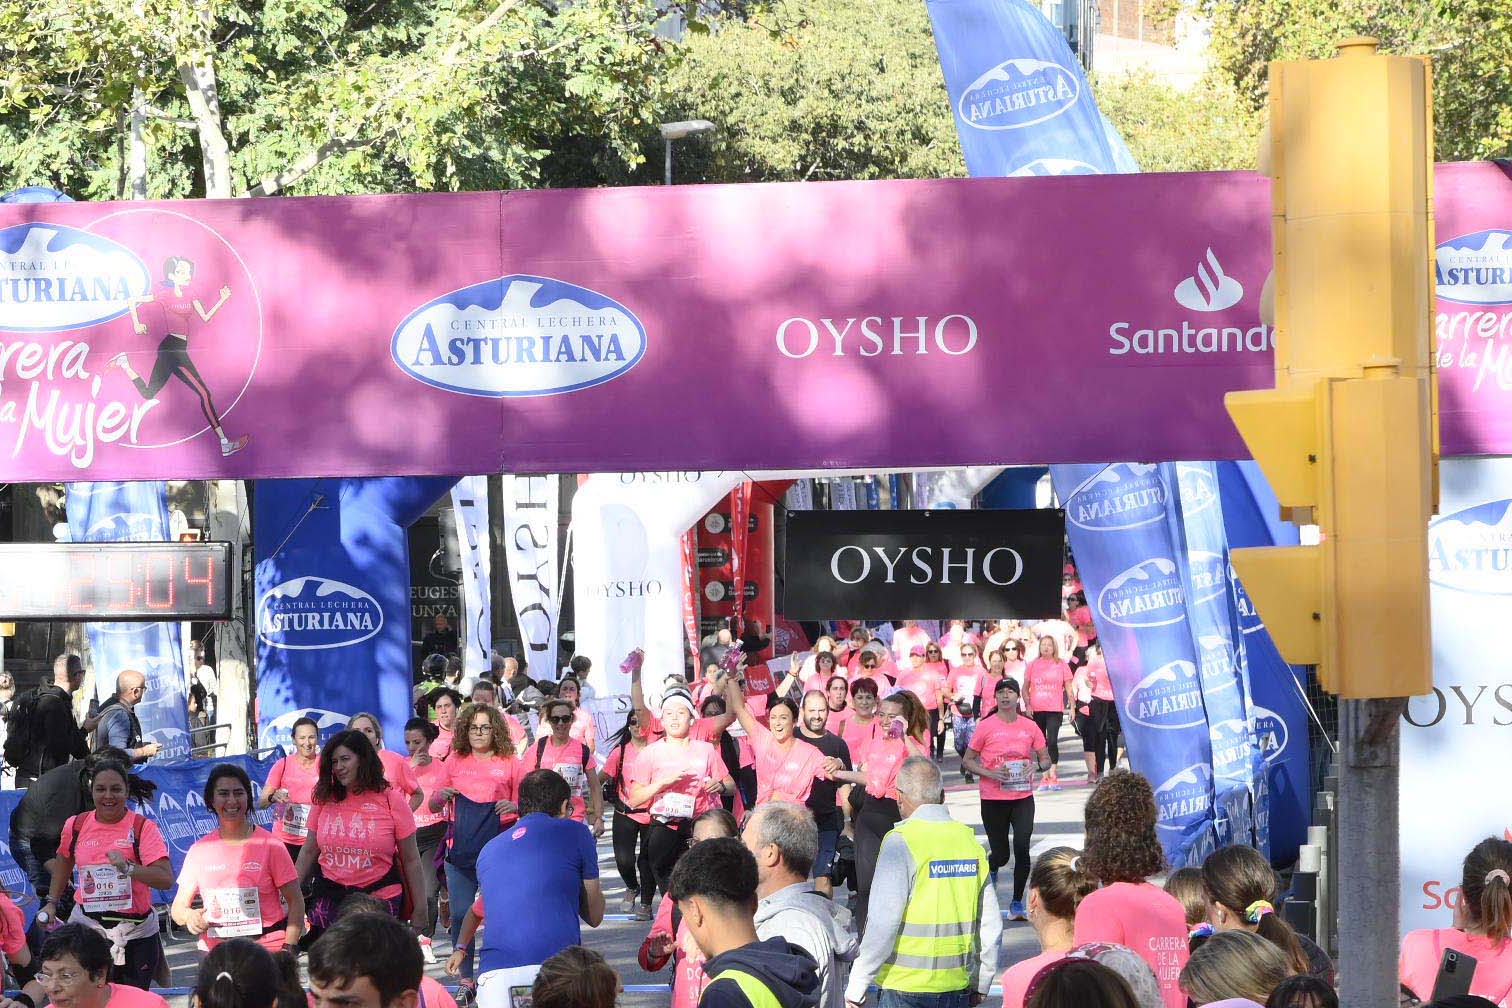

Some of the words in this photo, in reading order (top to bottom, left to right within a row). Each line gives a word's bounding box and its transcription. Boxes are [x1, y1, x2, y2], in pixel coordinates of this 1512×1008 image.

[450, 316, 529, 331] CENTRAL
[538, 315, 619, 330] LECHERA
[776, 313, 979, 359] OYSHO
[1109, 320, 1277, 355] Santand
[411, 323, 627, 368] ASTURIANA
[11, 373, 161, 469] Mujer
[829, 546, 1025, 586] OYSHO
[262, 607, 374, 634] ASTURIANA
[274, 601, 316, 610] CENTRAL
[321, 601, 370, 609] LECHERA
[1400, 683, 1512, 728] OYS
[326, 854, 374, 869] SUMA
[337, 846, 376, 857] DORSAL
[1148, 936, 1187, 953] CARRERA
